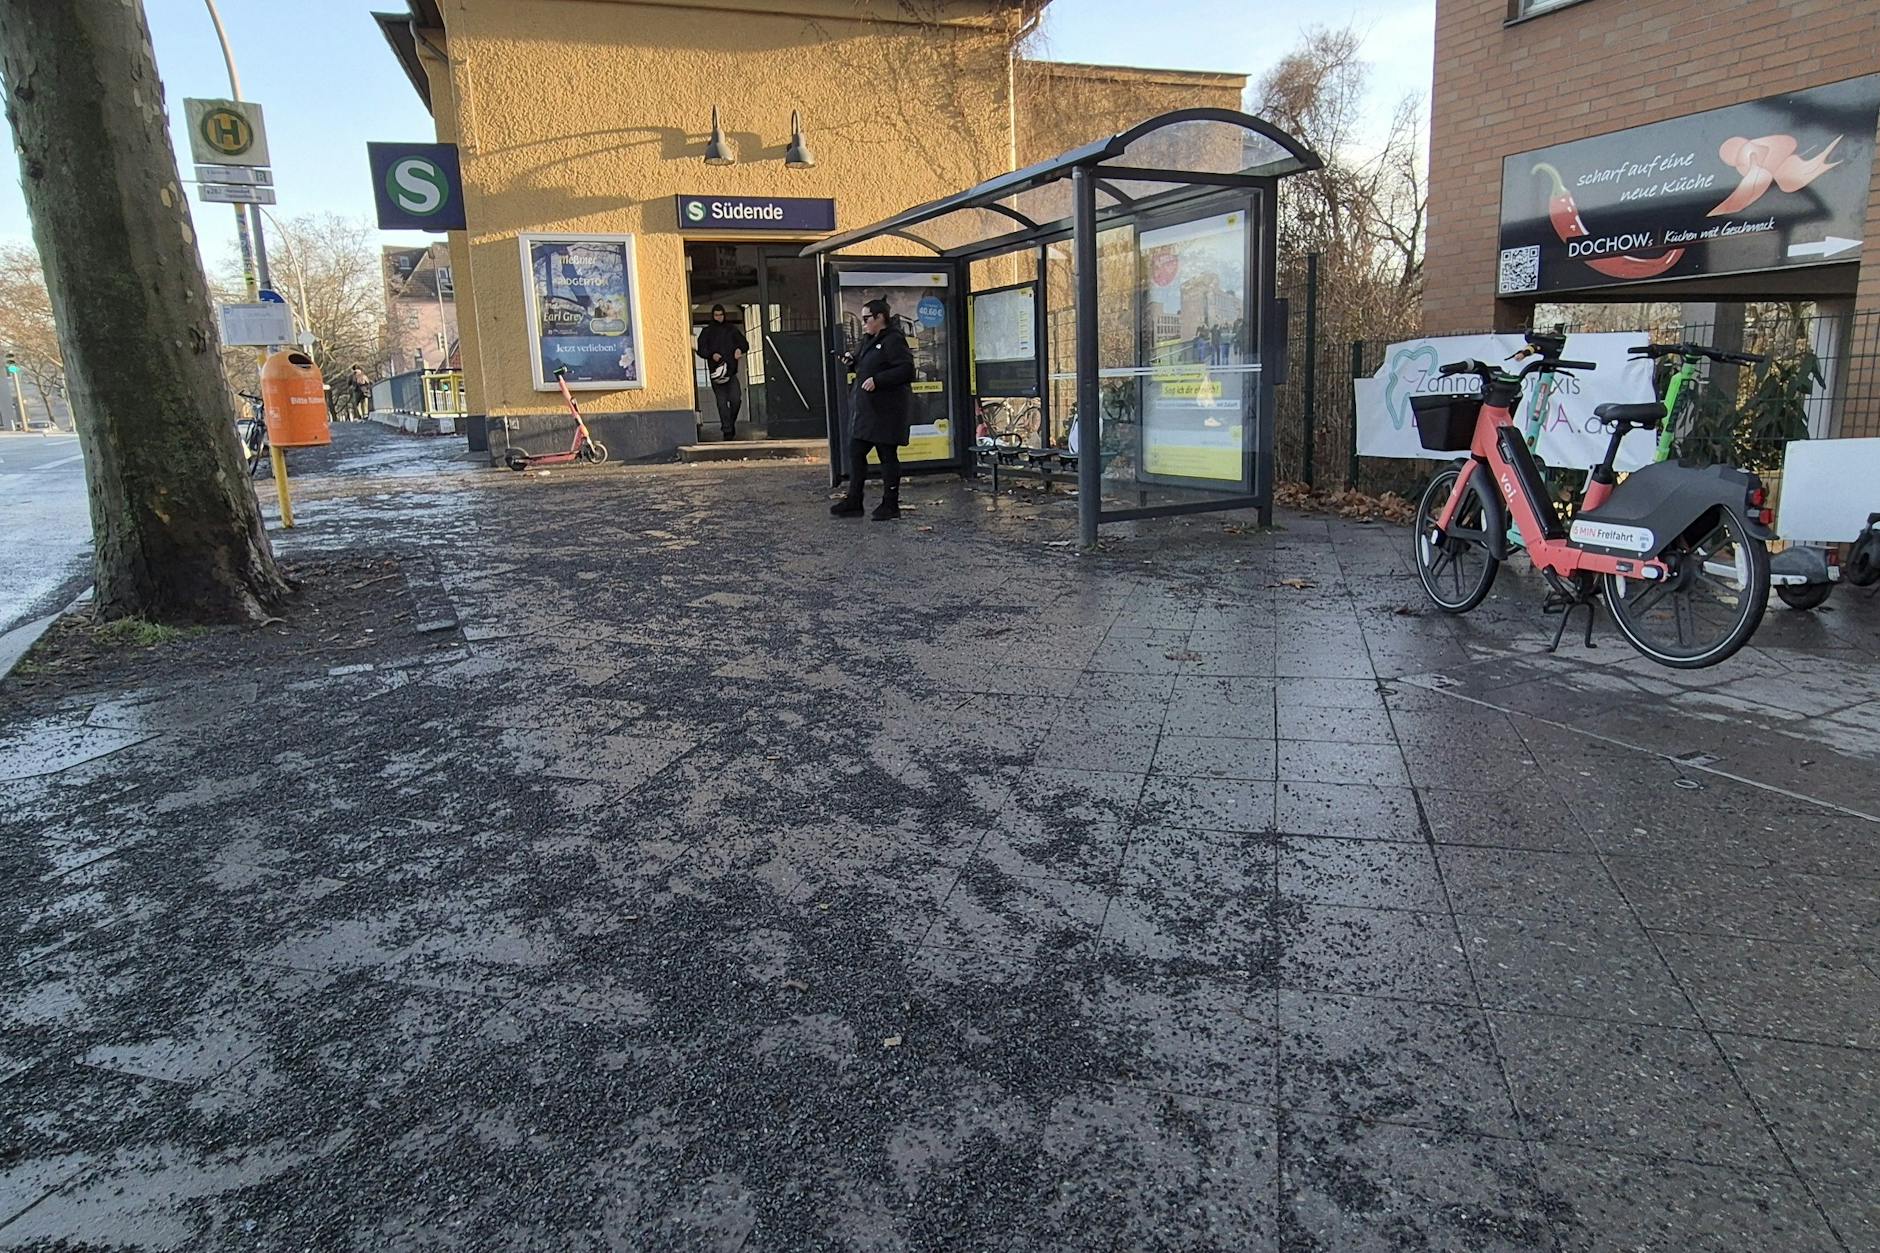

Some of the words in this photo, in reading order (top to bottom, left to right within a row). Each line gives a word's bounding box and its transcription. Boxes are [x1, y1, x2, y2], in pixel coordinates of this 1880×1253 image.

[213, 119, 241, 146] H
[1576, 162, 1629, 187] scharf
[1627, 155, 1662, 178] auf
[1659, 152, 1695, 171] eine
[394, 159, 441, 213] S
[1620, 185, 1658, 202] neue
[688, 201, 704, 221] S
[711, 202, 784, 221] Südende
[1664, 230, 1697, 245] Küchen
[1699, 226, 1719, 239] mit
[1721, 217, 1776, 236] Geschmack
[543, 311, 561, 323] Earl
[562, 311, 584, 325] Grey
[555, 343, 576, 353] Jetzt
[576, 343, 617, 353] verlieben!
[1579, 526, 1596, 537] MIN
[1597, 528, 1634, 542] Freifahrt
